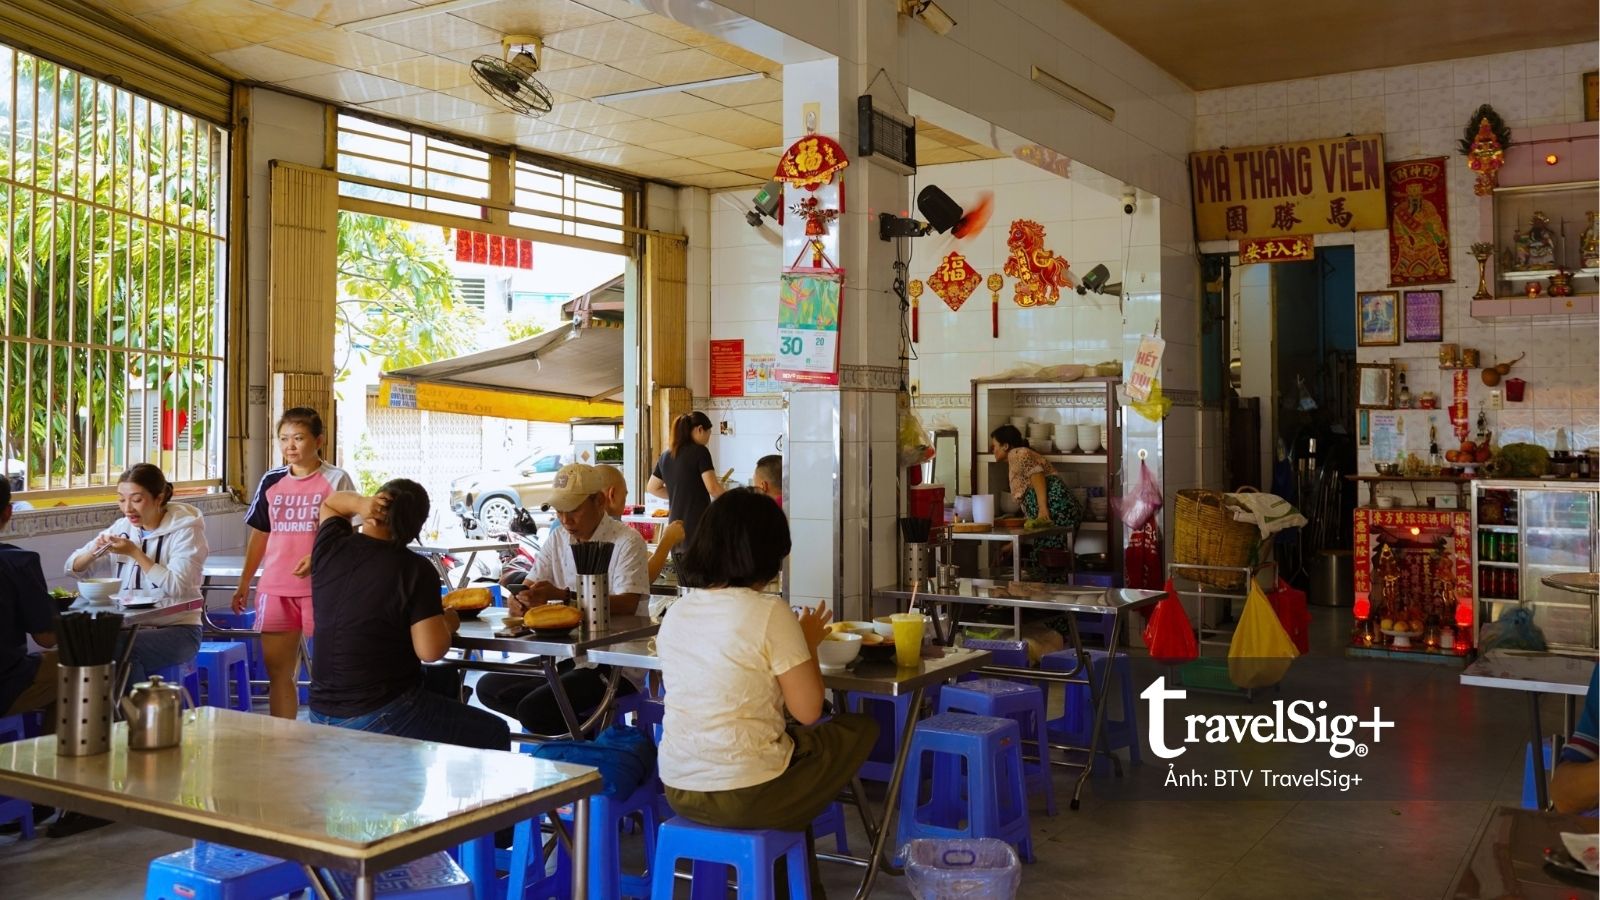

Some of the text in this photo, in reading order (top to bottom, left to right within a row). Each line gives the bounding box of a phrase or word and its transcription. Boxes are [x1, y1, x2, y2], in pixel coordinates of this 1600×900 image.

[795, 138, 823, 172] 福
[1234, 144, 1313, 200] THẮNG
[941, 255, 967, 282] 福
[780, 336, 825, 356] 30 20
[1136, 350, 1158, 368] HẾT
[273, 494, 322, 506] BUILD
[271, 507, 320, 520] YOUR
[272, 521, 319, 532] JOURNEY
